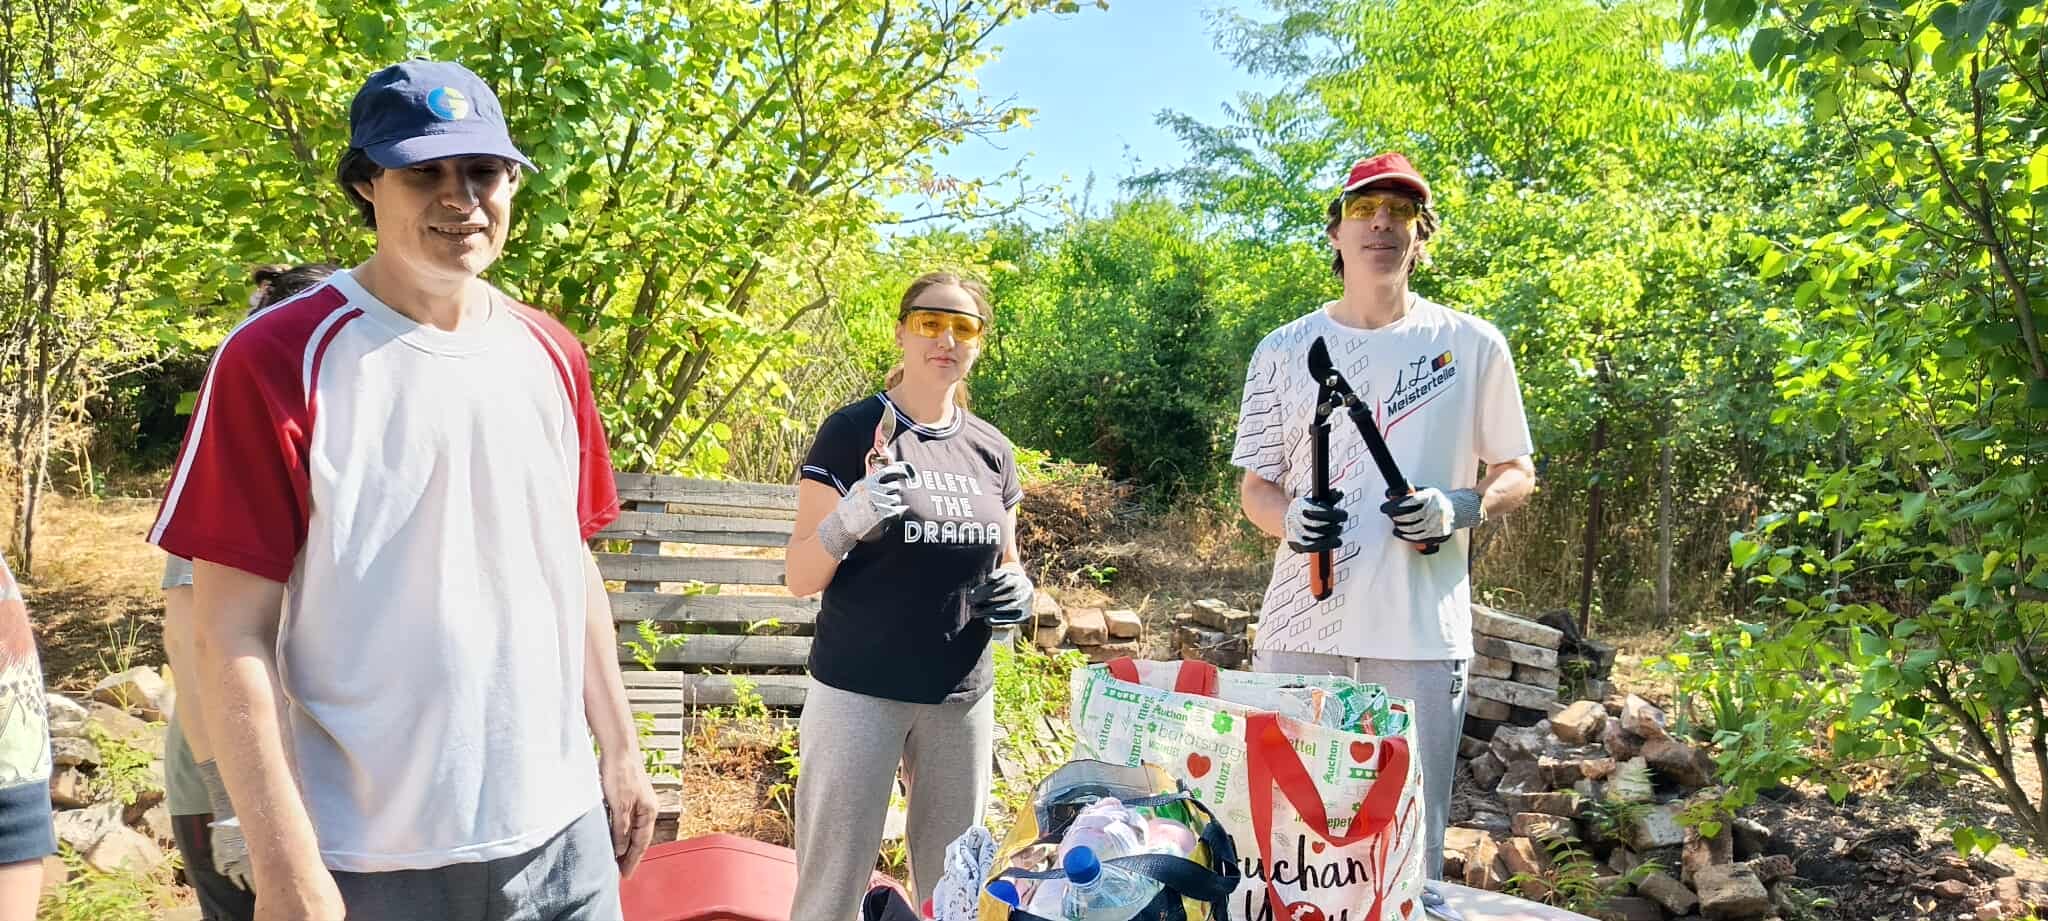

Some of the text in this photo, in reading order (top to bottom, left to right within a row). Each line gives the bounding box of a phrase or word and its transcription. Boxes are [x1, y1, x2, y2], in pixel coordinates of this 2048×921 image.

[930, 495, 974, 518] THE
[904, 520, 1000, 545] DRAMA
[1152, 704, 1188, 721] Auchan
[1323, 740, 1339, 784] Auchan
[1230, 834, 1368, 891] uchan
